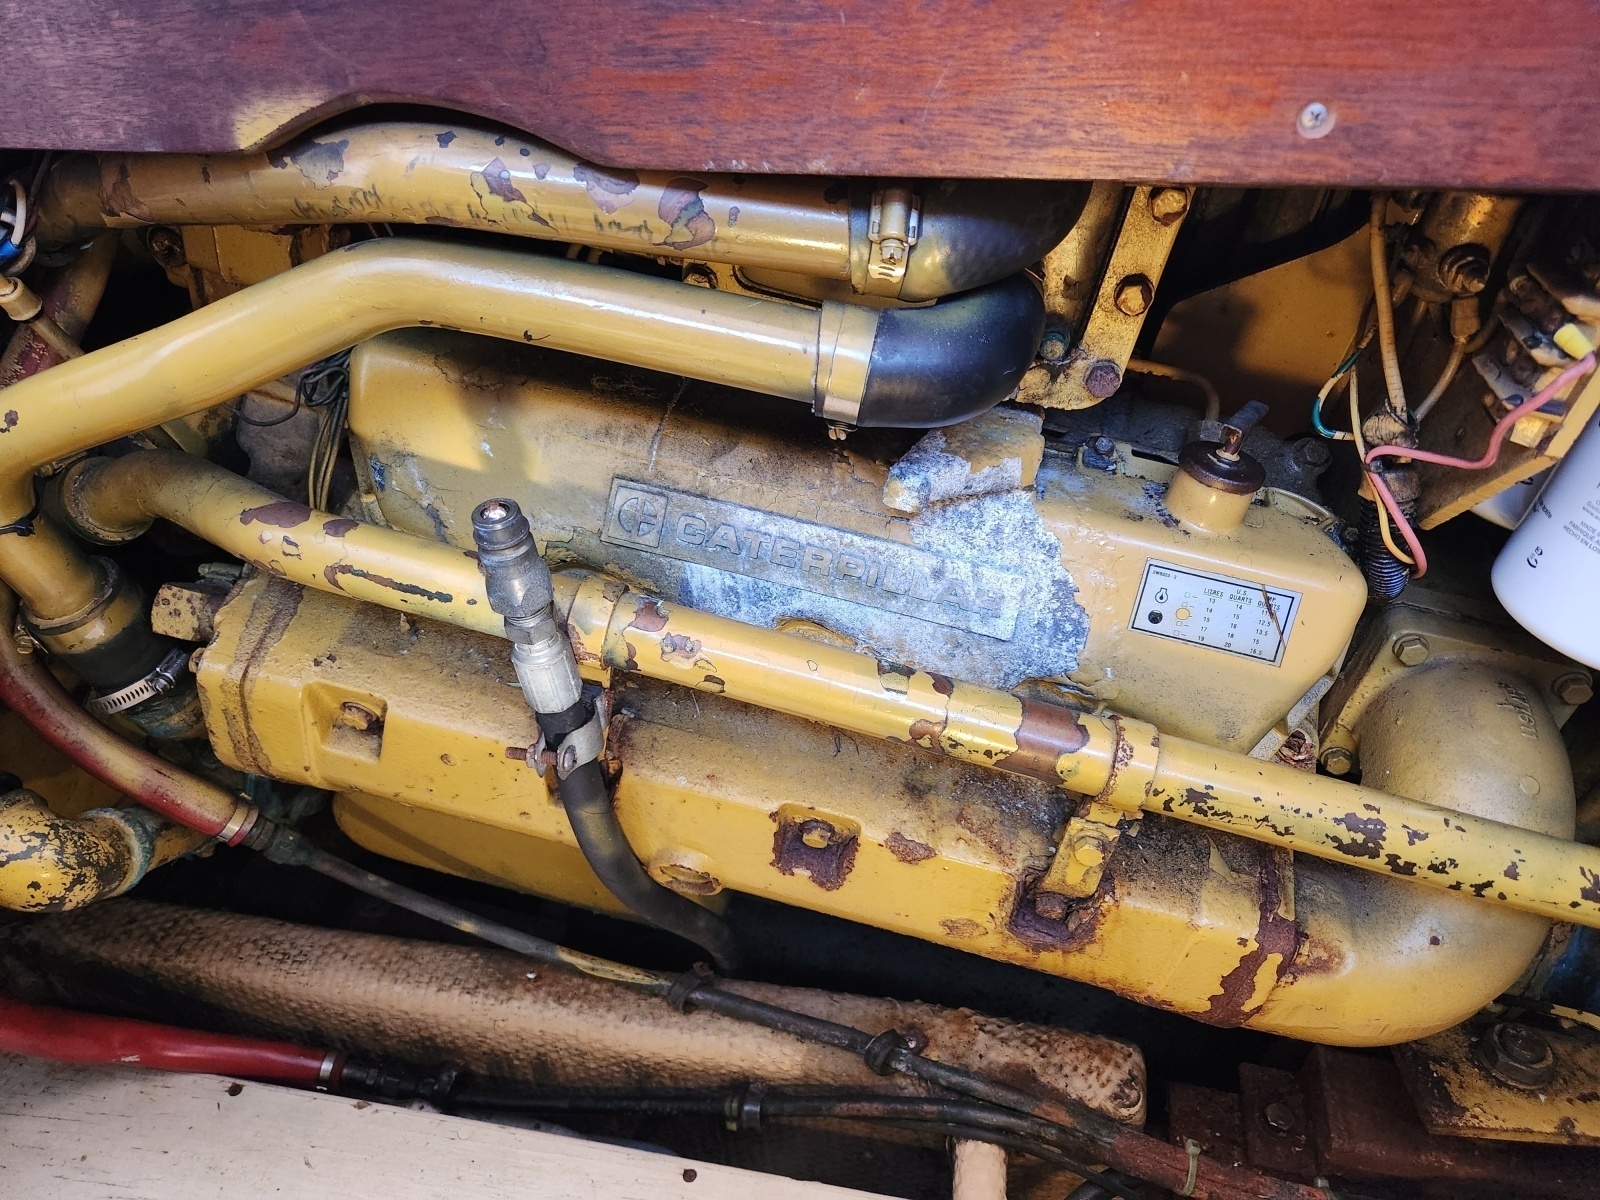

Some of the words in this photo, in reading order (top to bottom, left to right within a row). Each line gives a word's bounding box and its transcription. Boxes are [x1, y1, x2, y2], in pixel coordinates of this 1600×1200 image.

[1563, 525, 1581, 541] HECHO
[1580, 538, 1589, 547] EN
[1580, 520, 1597, 535] MADE
[676, 513, 1007, 618] CATERPILLAR
[1229, 593, 1253, 604] QUARTS
[1257, 600, 1281, 611] QURTS
